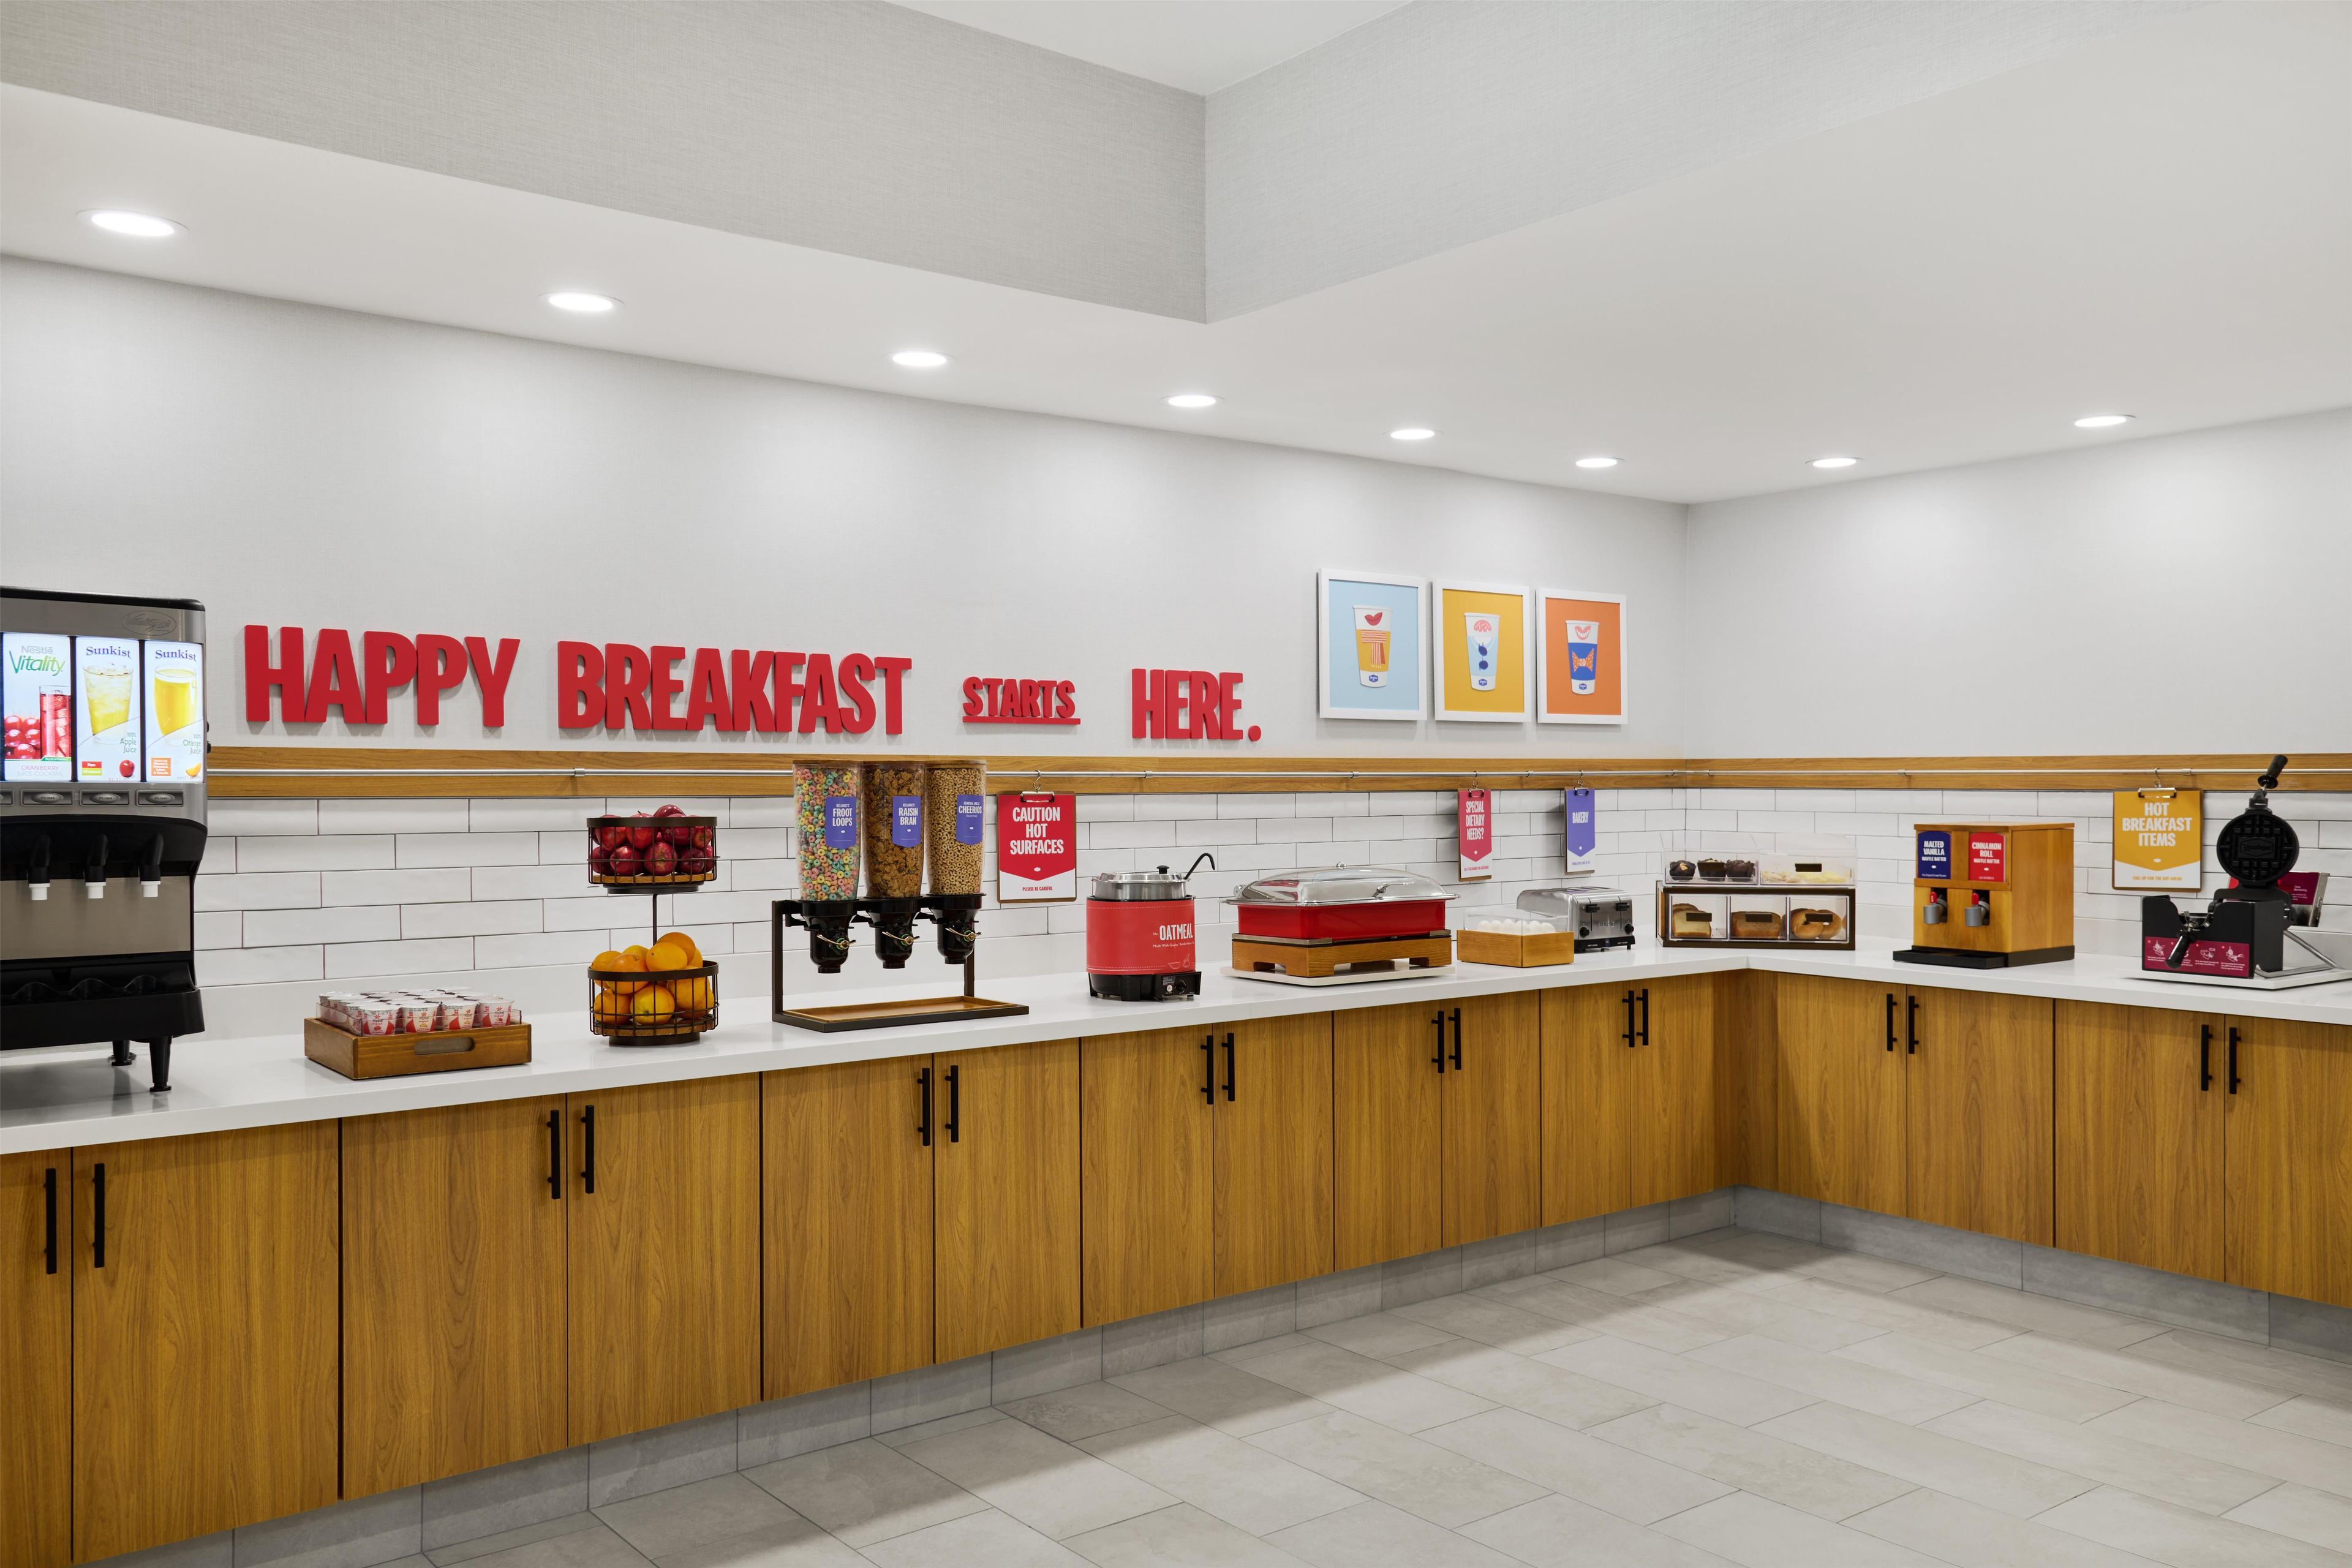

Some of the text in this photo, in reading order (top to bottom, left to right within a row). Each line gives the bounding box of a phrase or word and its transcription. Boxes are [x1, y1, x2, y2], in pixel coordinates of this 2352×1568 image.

[86, 646, 131, 658] Sunkist
[155, 649, 197, 662] Sunkist
[9, 650, 66, 676] Vitality
[244, 625, 1262, 741] HAPPY BREAKFAST STARTS HERE.
[119, 738, 137, 747] Apple
[183, 739, 201, 748] Orange
[833, 809, 853, 817] FROOT
[899, 807, 918, 816] RAISIN
[1466, 801, 1485, 813] SPECIAL
[2144, 802, 2169, 816] HOT
[900, 816, 917, 825] BRAN
[1012, 807, 1060, 822] CAUTION
[1466, 814, 1485, 827] DIETARY
[1572, 812, 1589, 824] BAKERY
[832, 817, 853, 826] LOOPS
[2122, 817, 2192, 831] BREAKFAST
[1026, 823, 1048, 838] HOT
[1467, 827, 1484, 840] NEEDS?
[2138, 832, 2176, 846] ITEMS
[1010, 839, 1064, 855] SURFACES
[1159, 923, 1193, 941] OATMEAL
